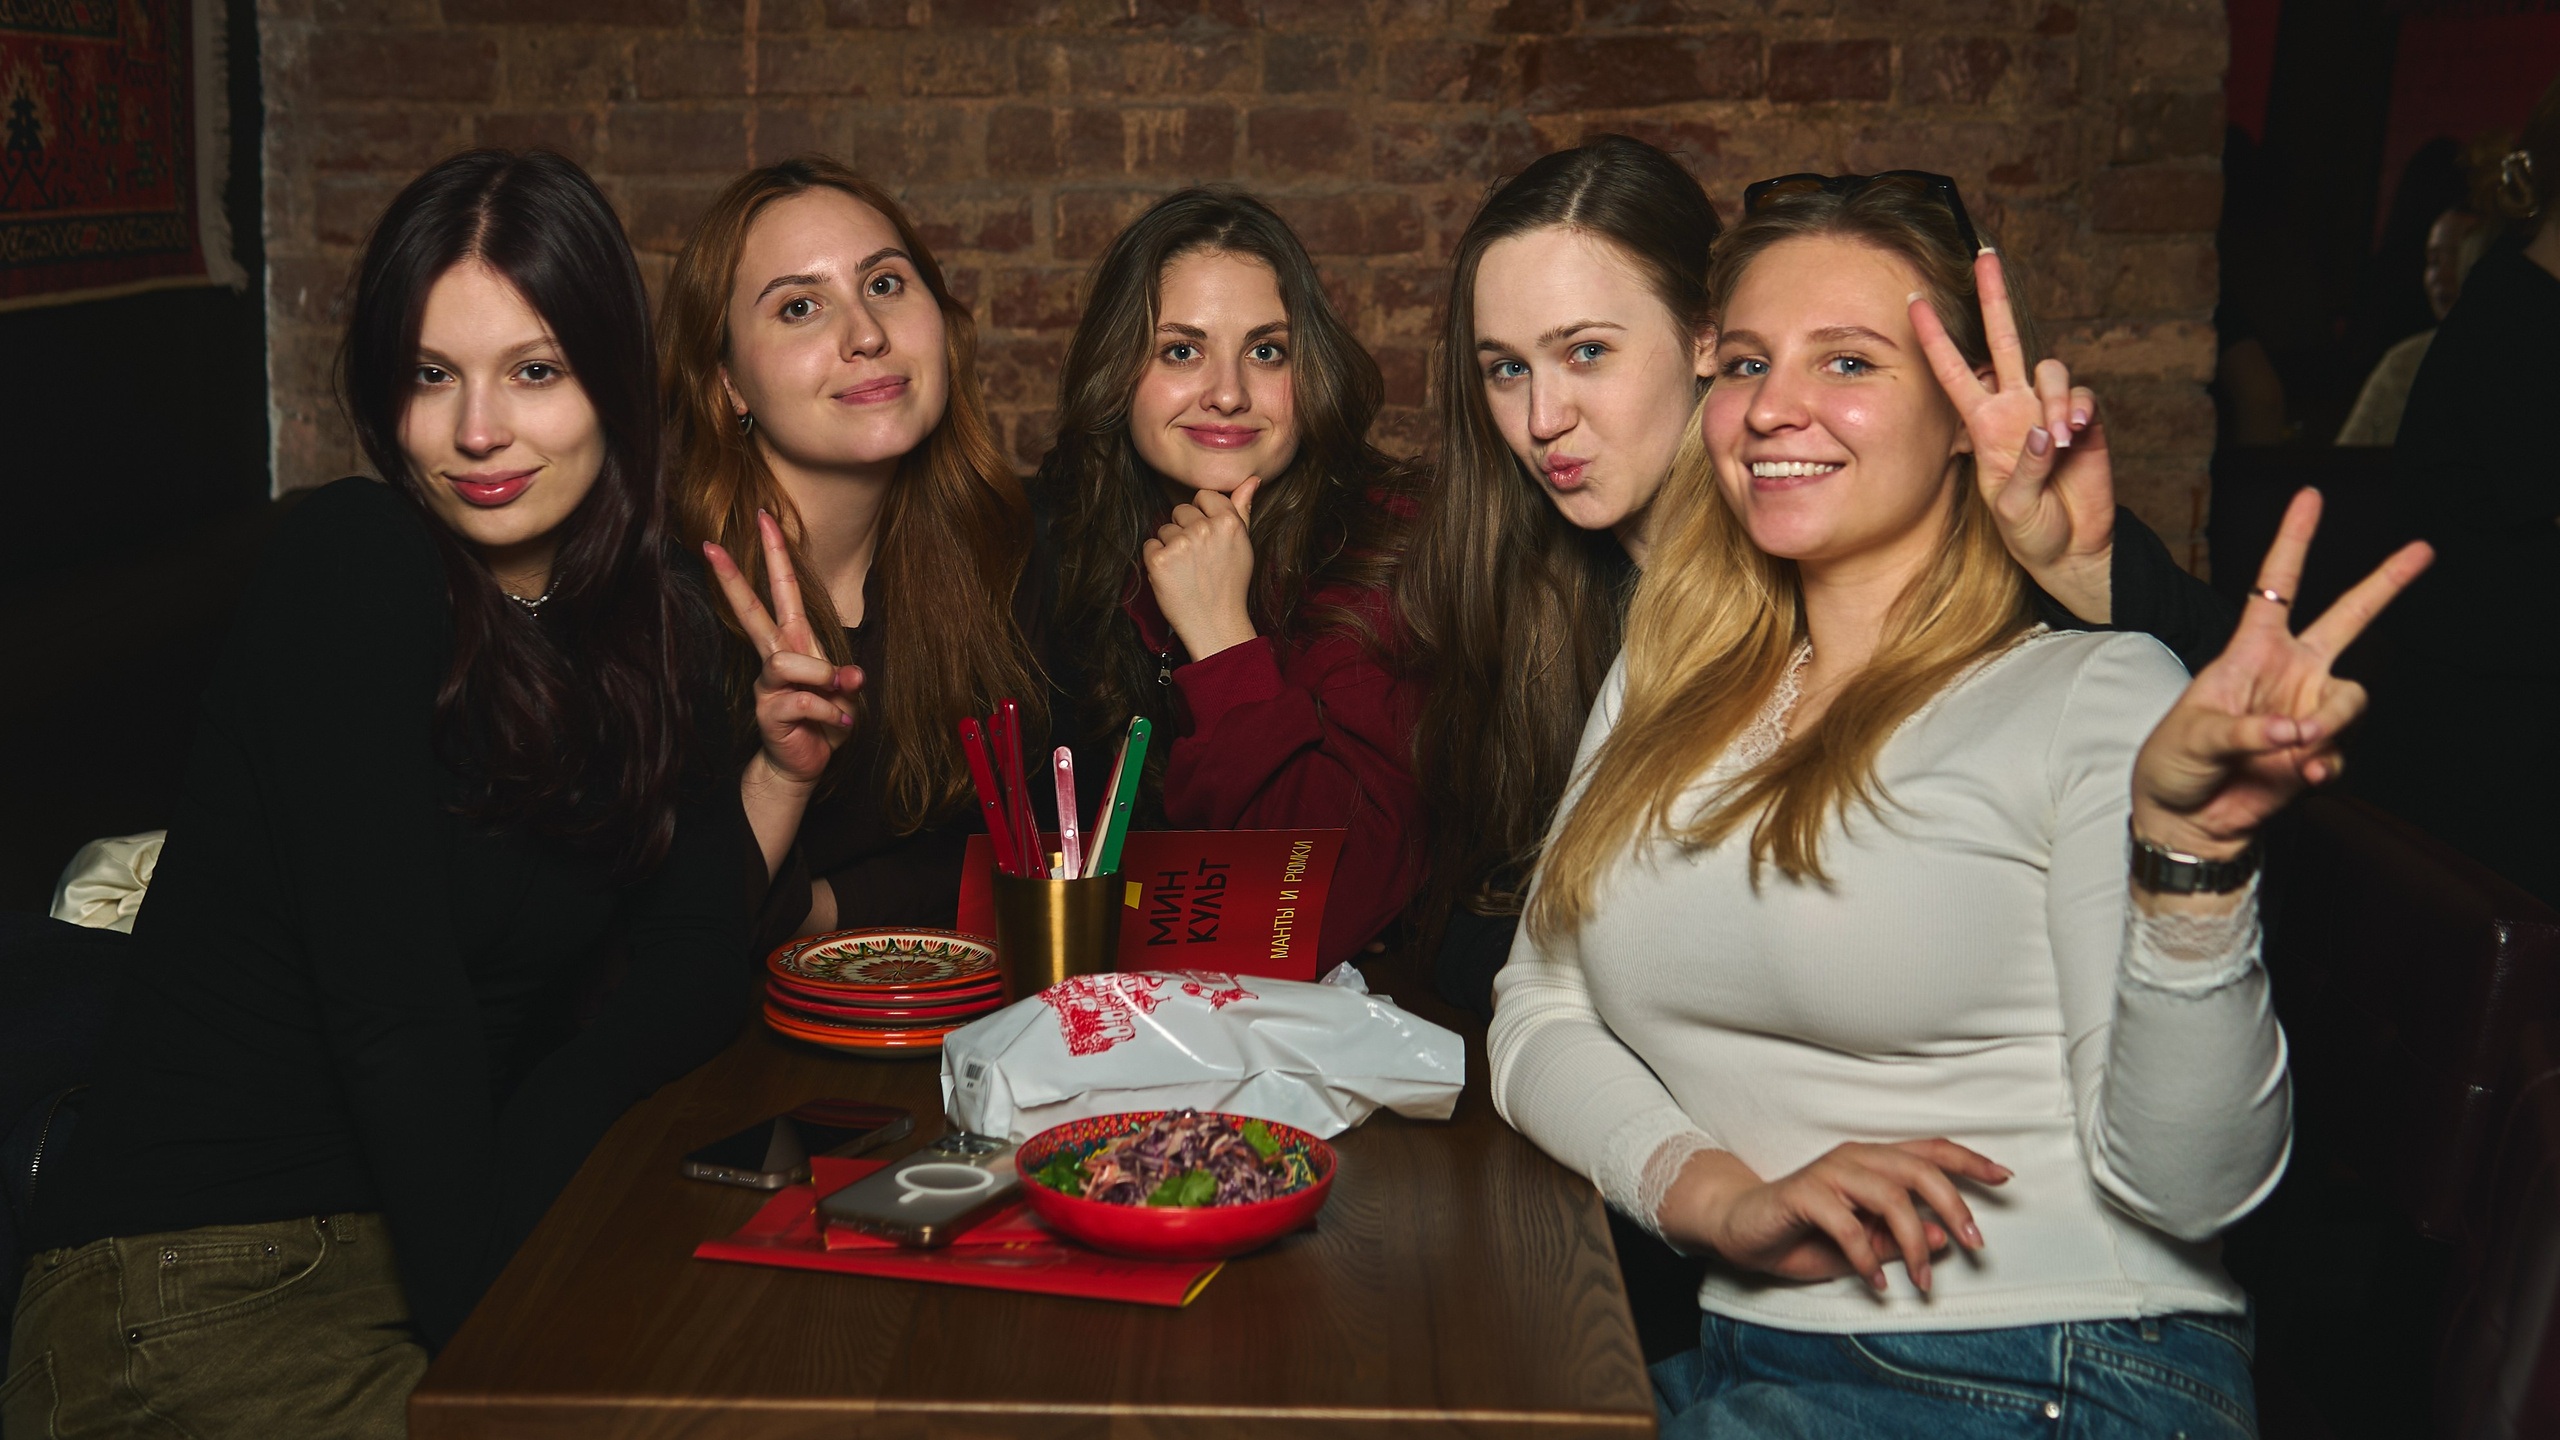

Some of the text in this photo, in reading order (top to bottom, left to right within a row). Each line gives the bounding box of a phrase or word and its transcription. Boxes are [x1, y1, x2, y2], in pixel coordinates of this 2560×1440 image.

[1147, 870, 1189, 946] МИН
[1187, 857, 1231, 944] КУЛЬТ
[1270, 840, 1314, 959] МАНТЫ И РЮМКИ
